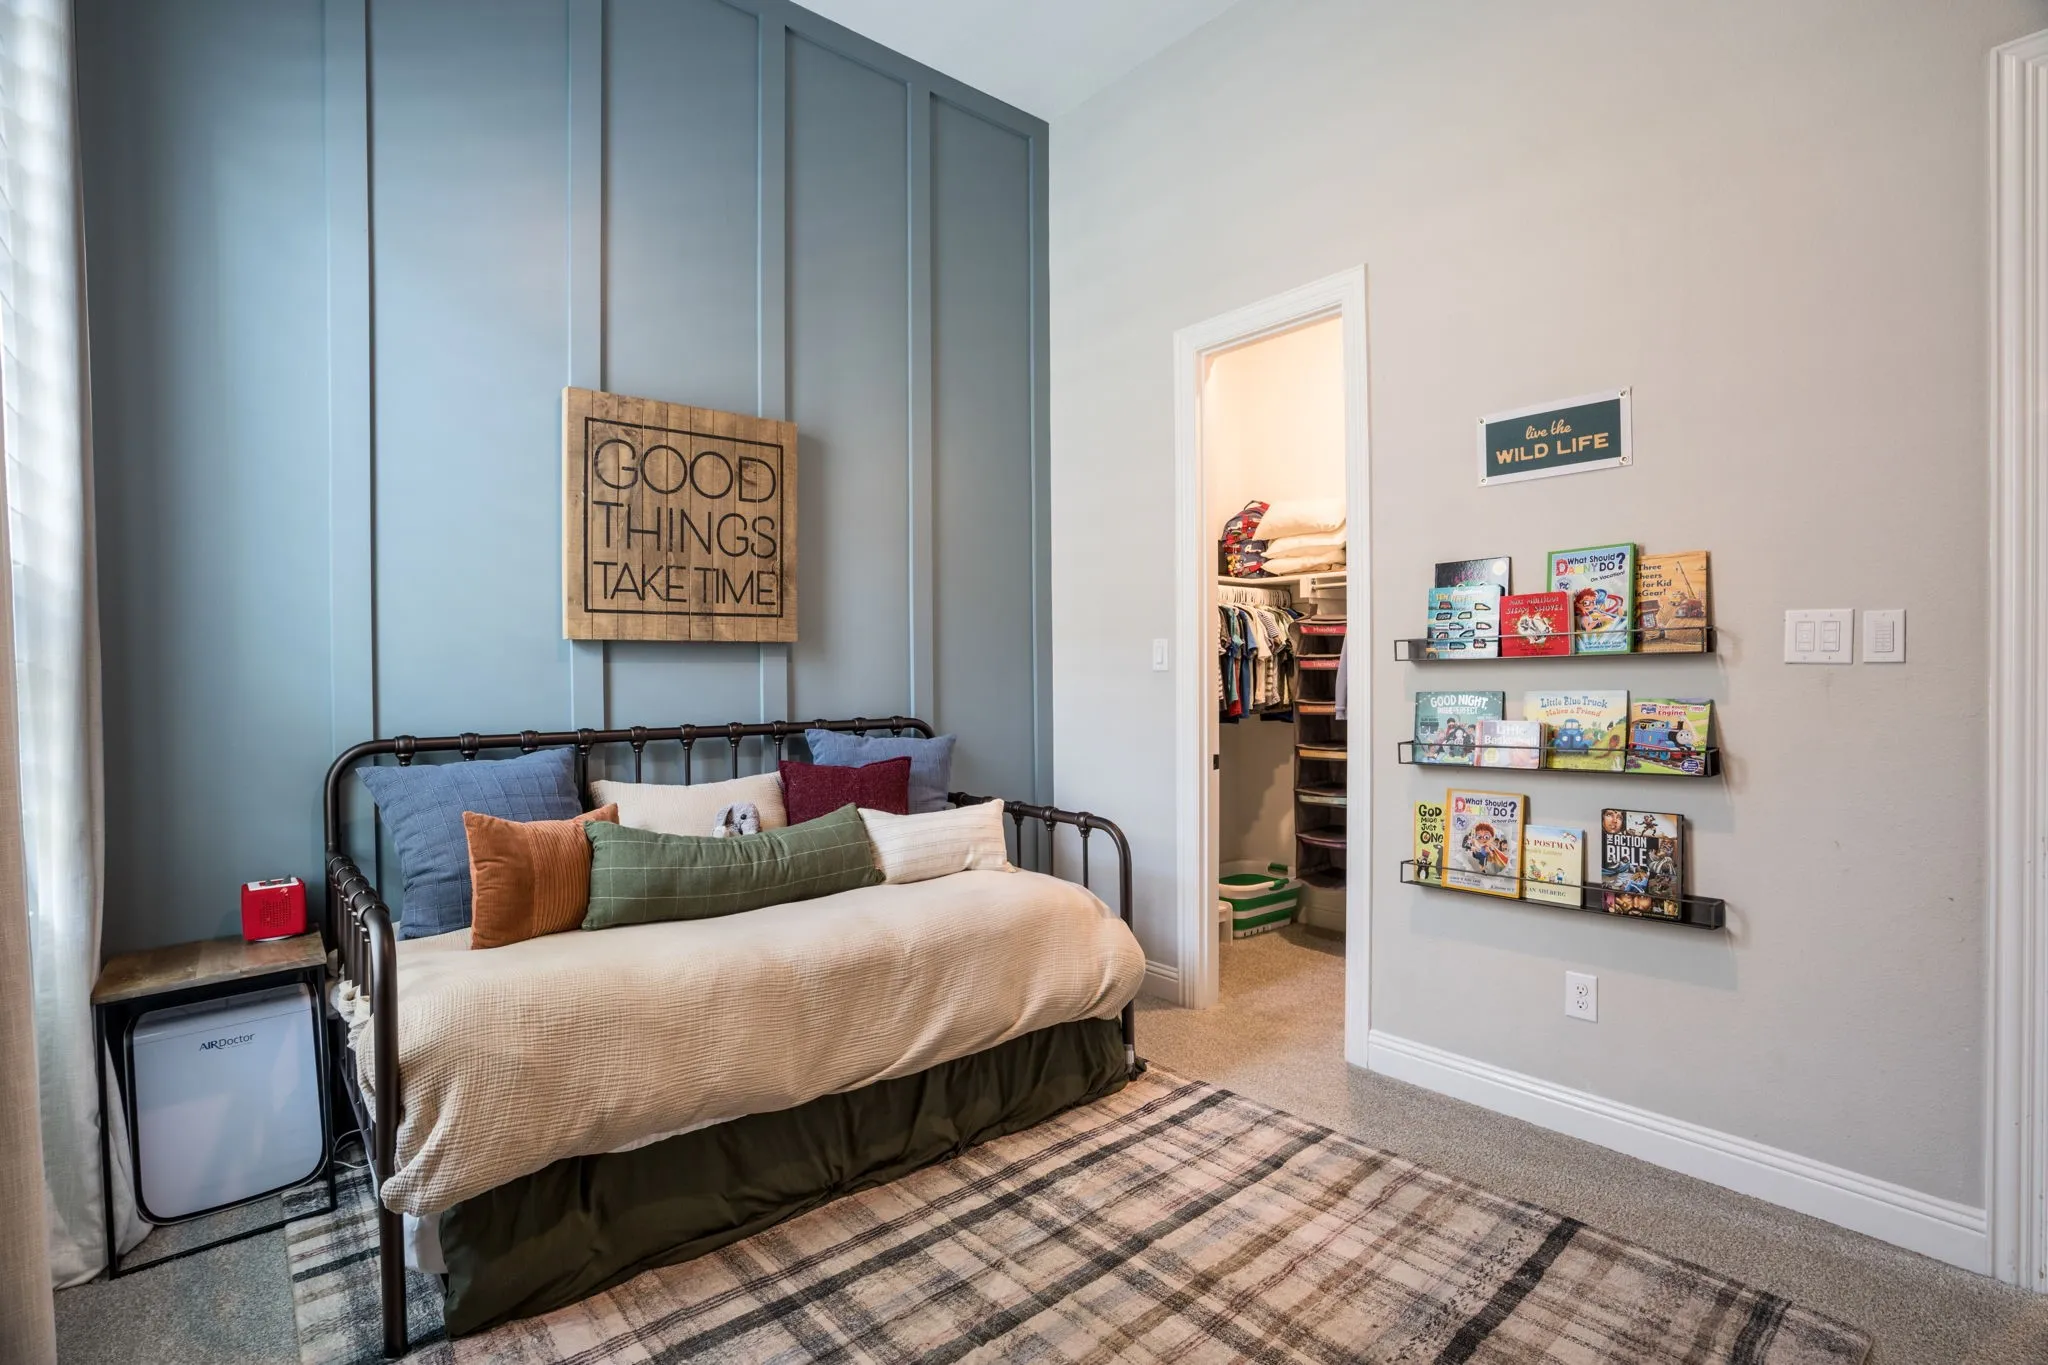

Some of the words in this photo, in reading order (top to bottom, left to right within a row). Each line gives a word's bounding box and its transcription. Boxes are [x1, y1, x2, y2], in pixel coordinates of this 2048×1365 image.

[1525, 425, 1549, 440] live
[1550, 419, 1572, 436] the
[1496, 443, 1549, 465] WILD
[1557, 432, 1609, 455] LIFE
[593, 438, 777, 503] GOOD
[592, 500, 777, 560] THINGS
[1567, 557, 1587, 565] What
[1589, 553, 1616, 563] Should
[1637, 563, 1662, 571] Three
[593, 561, 687, 602] TAKE
[694, 566, 777, 606] TIME
[1642, 580, 1655, 588] for
[1656, 579, 1672, 587] Kid
[1635, 589, 1666, 597] cGear!
[1430, 695, 1457, 708] GOOD
[1540, 697, 1562, 708] Little
[1563, 695, 1581, 706] Blue
[1582, 695, 1608, 709] Truck
[1545, 708, 1569, 717] Makes
[1576, 707, 1602, 717] Friend
[1485, 799, 1508, 808] Should
[1534, 839, 1575, 851] POSTMAN
[1606, 833, 1614, 844] THE
[1614, 834, 1647, 848] ACTION
[1607, 845, 1647, 867] BIBLE
